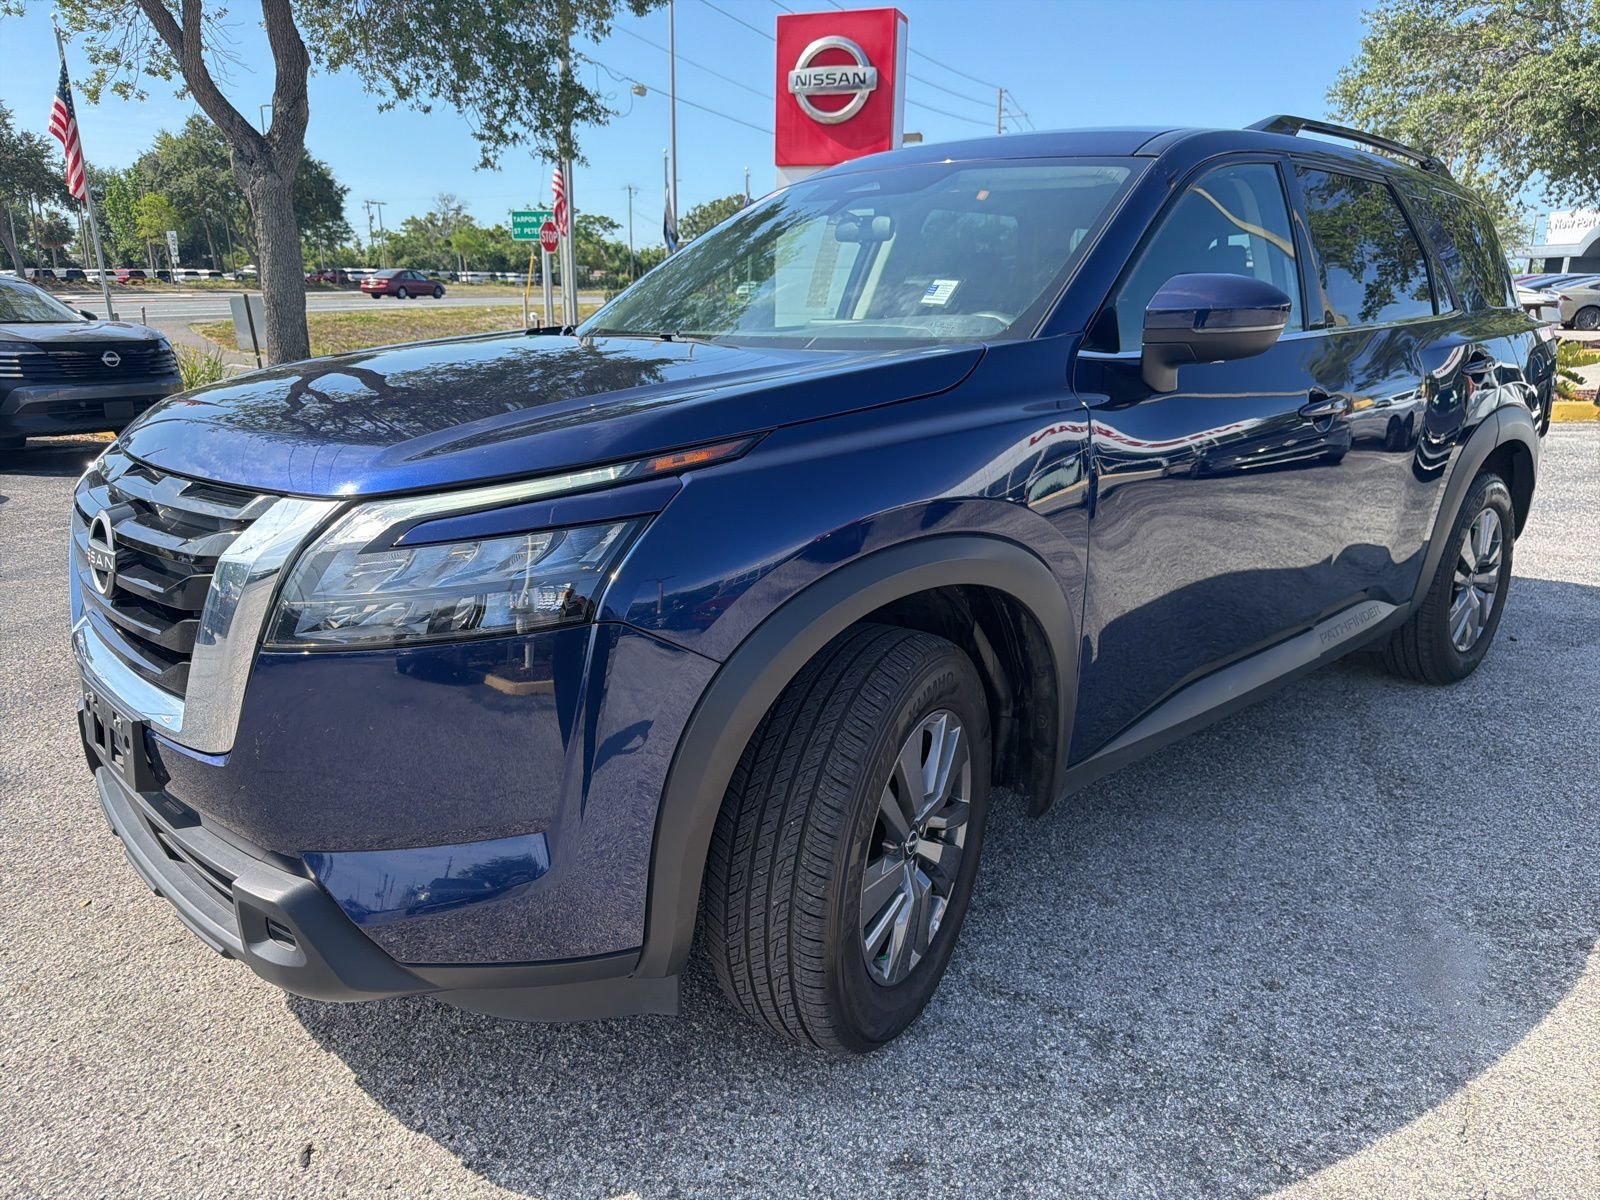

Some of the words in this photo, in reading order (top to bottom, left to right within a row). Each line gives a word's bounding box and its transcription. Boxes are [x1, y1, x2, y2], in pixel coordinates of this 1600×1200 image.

[795, 72, 866, 87] NISSAN
[541, 230, 558, 243] STOP
[1319, 605, 1382, 645] PATHFINDER
